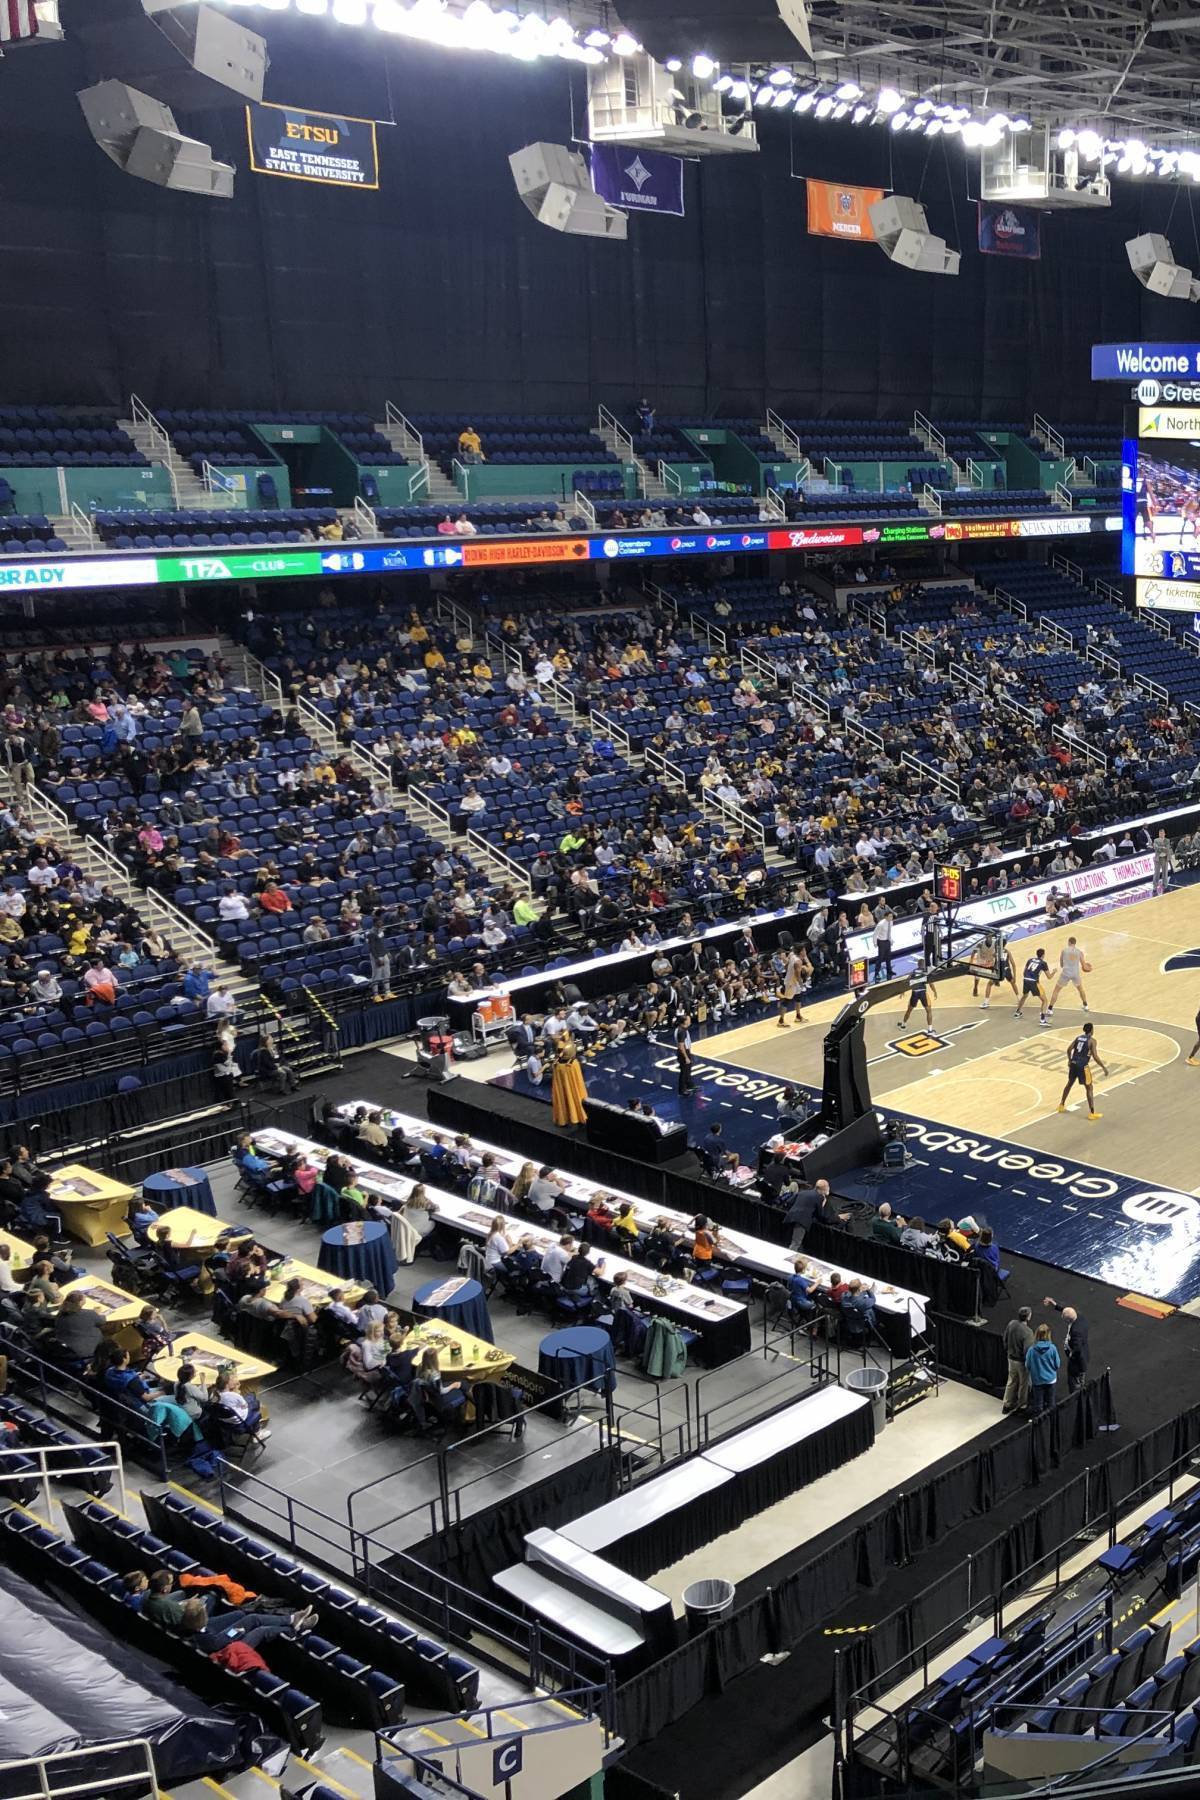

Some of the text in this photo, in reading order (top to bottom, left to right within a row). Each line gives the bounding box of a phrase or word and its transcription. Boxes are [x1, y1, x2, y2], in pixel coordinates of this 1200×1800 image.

[286, 122, 338, 145] ETSU
[269, 147, 360, 171] EAST TENNESSEE
[265, 158, 365, 183] STATE UNIVERSITY
[832, 221, 861, 235] MERCER
[1117, 347, 1189, 373] Welcome
[789, 532, 845, 547] Budweiser
[465, 548, 488, 562] RIDING
[489, 546, 506, 560] HIGH
[180, 560, 232, 579] TFA
[252, 560, 286, 571] CLUB
[1072, 870, 1108, 894] LOCATIONS
[987, 896, 1017, 915] TFA
[499, 1745, 517, 1772] C
